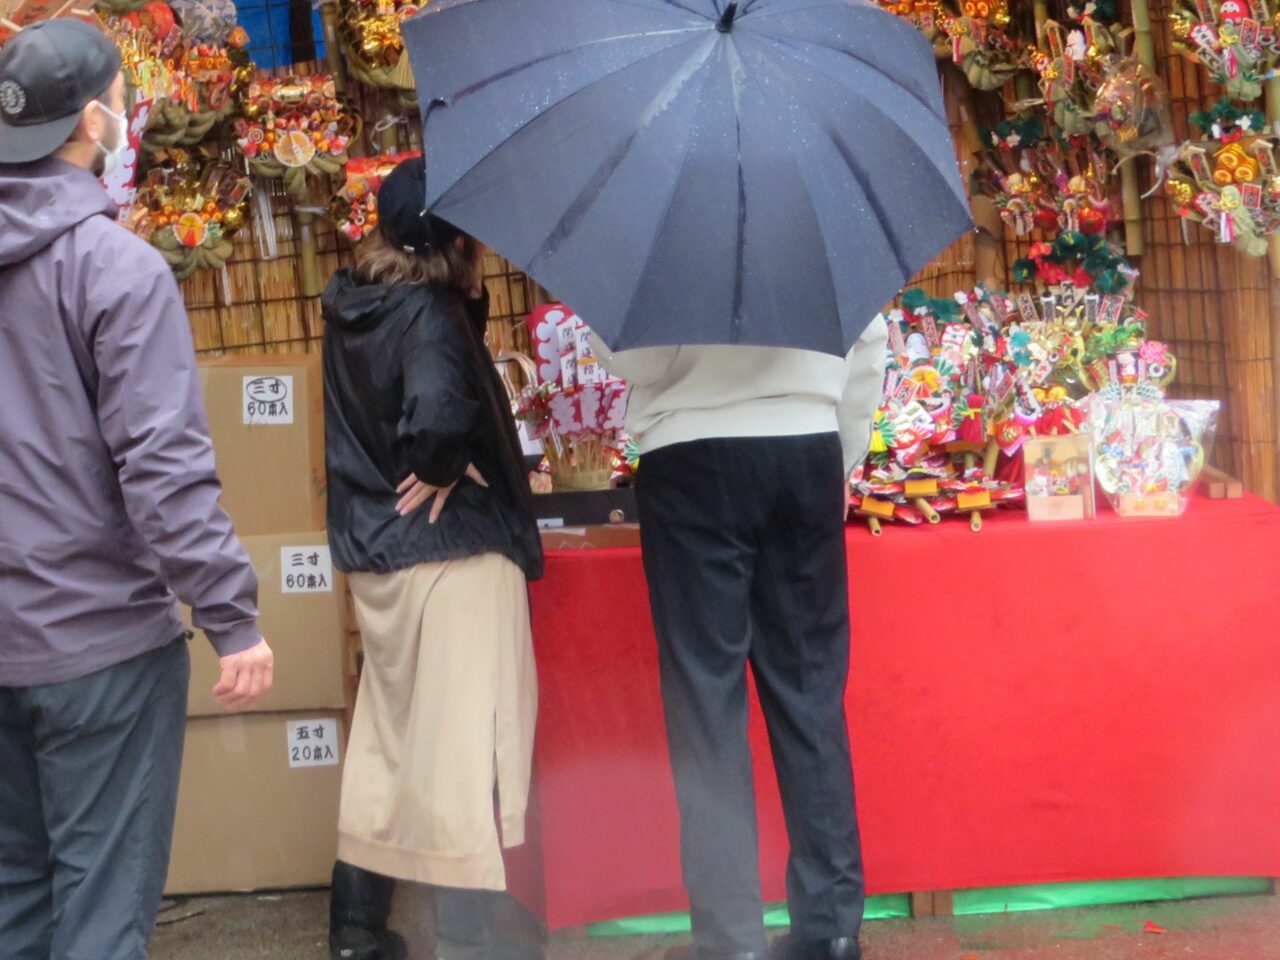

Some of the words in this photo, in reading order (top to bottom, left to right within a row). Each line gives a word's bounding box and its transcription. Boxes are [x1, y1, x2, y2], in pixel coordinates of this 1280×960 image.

[251, 379, 281, 395] 三寸
[291, 551, 319, 566] 三寸
[296, 724, 325, 740] 五寸
